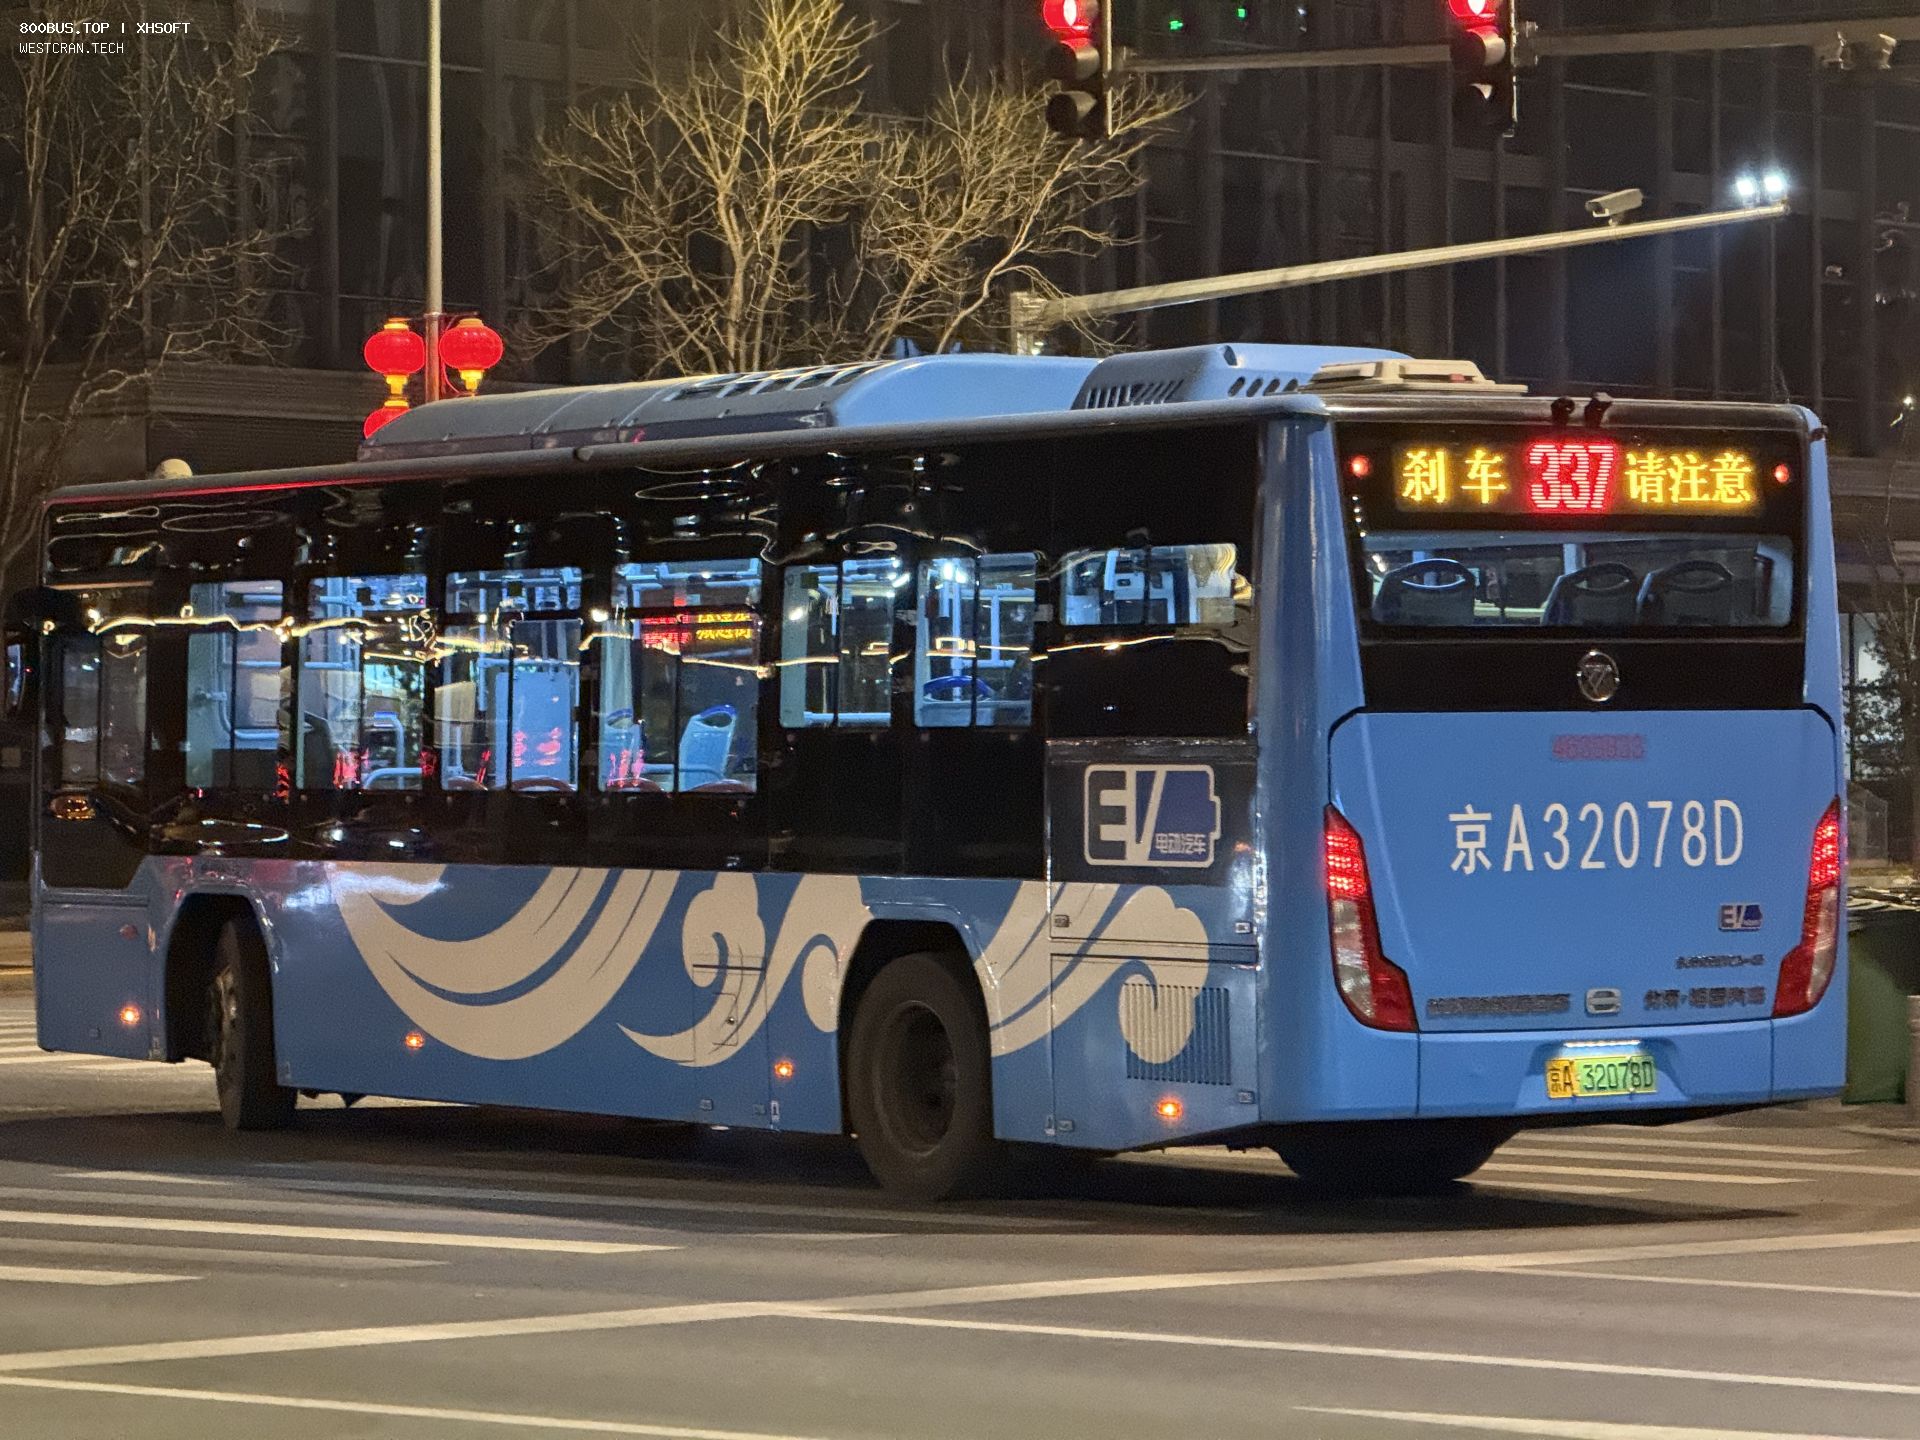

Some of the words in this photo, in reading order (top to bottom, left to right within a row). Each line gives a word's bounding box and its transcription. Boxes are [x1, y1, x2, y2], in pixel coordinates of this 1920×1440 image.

[1528, 444, 1614, 510] 337
[1625, 451, 1752, 506] 请注意
[1448, 799, 1744, 875] 京A32078D
